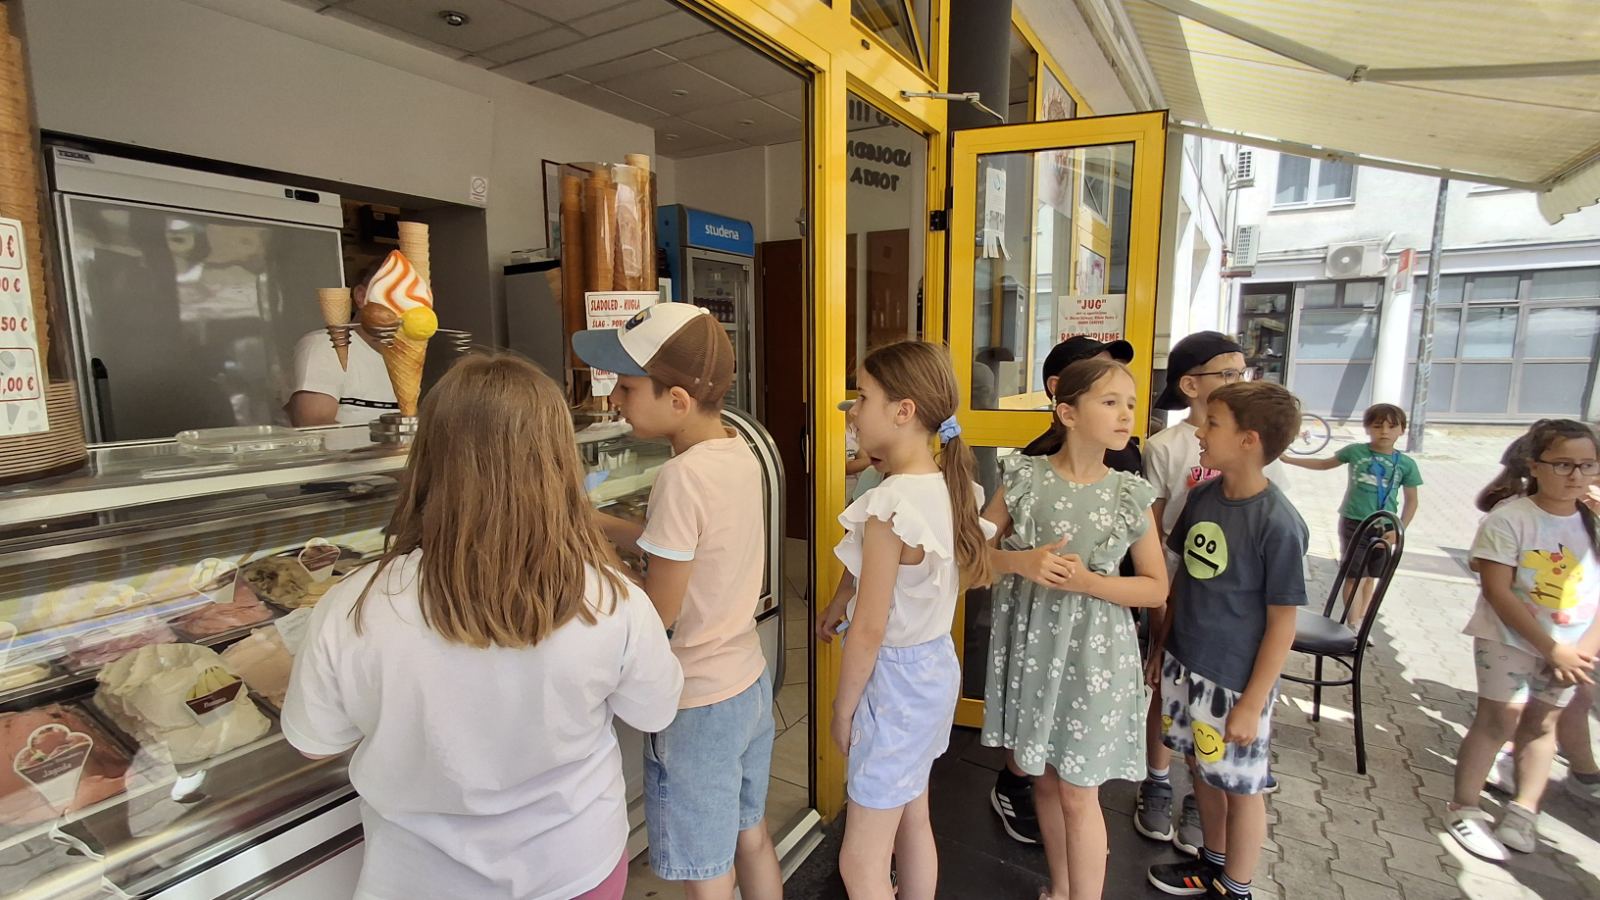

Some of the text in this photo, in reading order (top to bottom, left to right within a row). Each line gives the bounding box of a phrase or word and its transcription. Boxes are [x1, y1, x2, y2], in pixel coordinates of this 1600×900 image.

[705, 224, 740, 241] studena
[590, 299, 619, 311] SLADOLED
[624, 298, 641, 311] KUGLA
[1076, 299, 1107, 310] "JUG"
